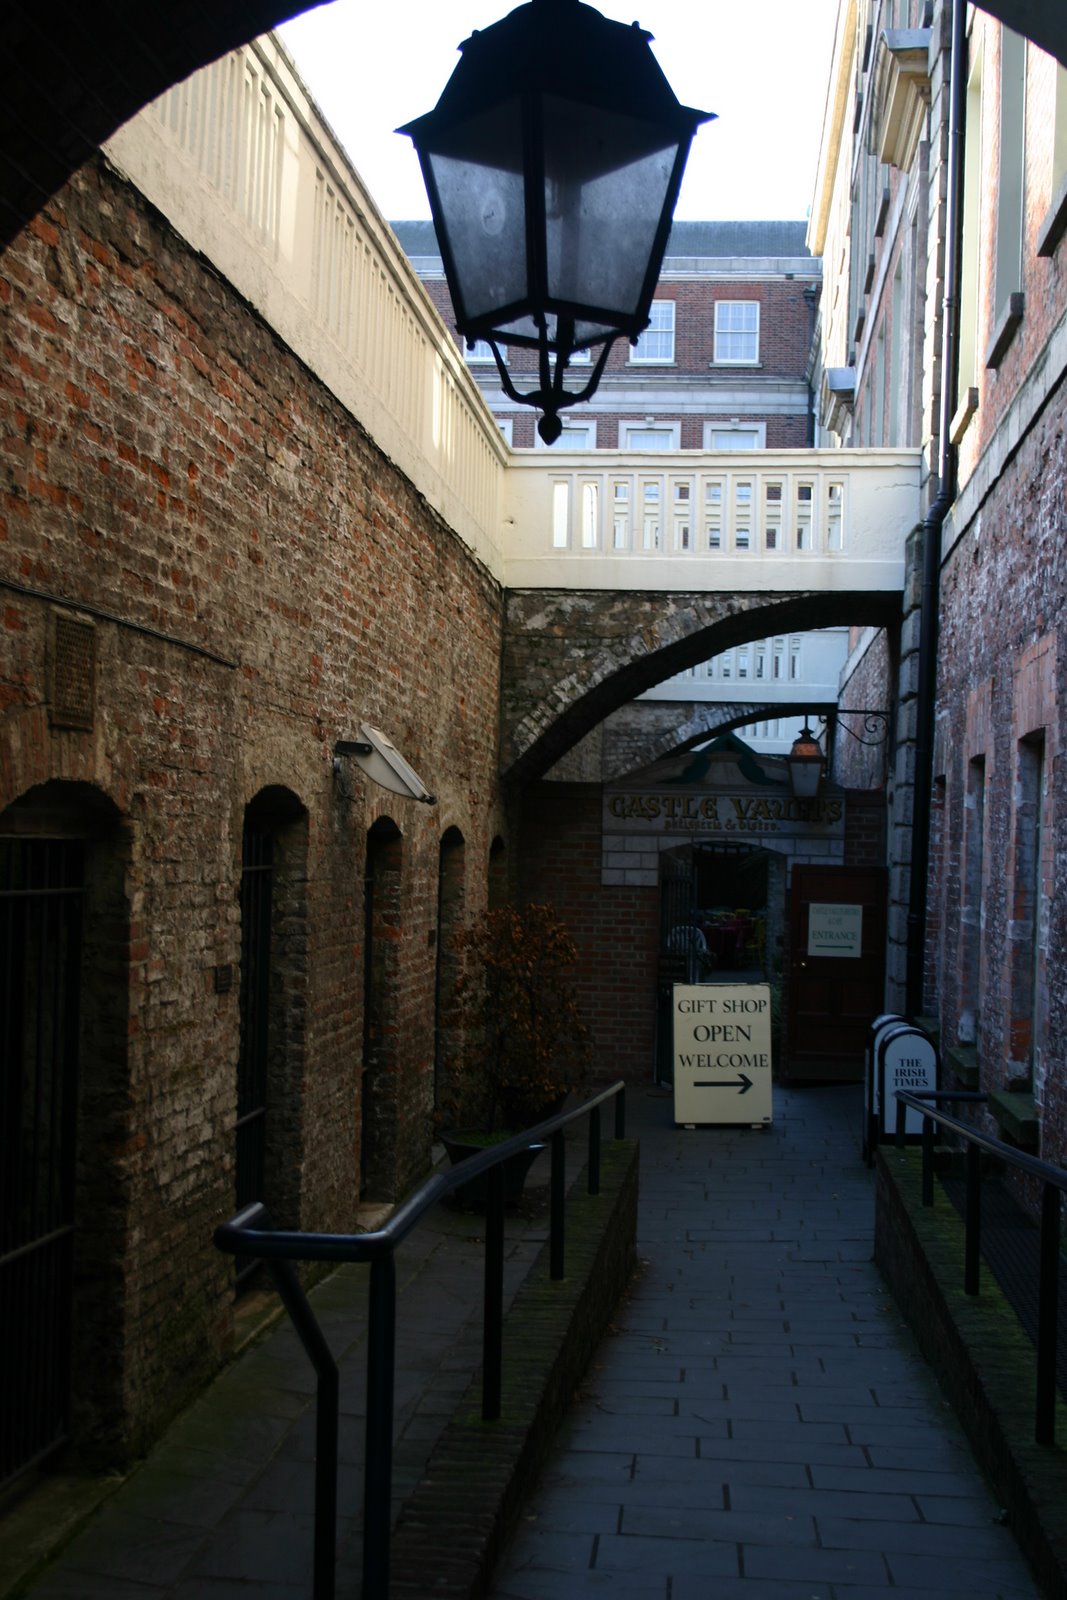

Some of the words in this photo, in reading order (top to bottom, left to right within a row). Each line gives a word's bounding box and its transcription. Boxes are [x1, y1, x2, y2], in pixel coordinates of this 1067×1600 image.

[608, 796, 719, 821] CASTLE
[730, 797, 842, 825] VAULTS
[725, 819, 736, 830] &
[812, 930, 856, 941] ENTRANCE
[678, 1000, 717, 1014] GIFT
[723, 1000, 767, 1014] SHOP
[693, 1025, 752, 1042] OPEN
[679, 1054, 769, 1068] WELCOME
[898, 1058, 922, 1068] THE
[895, 1068, 926, 1077] IRISH
[893, 1077, 928, 1087] TIMES
